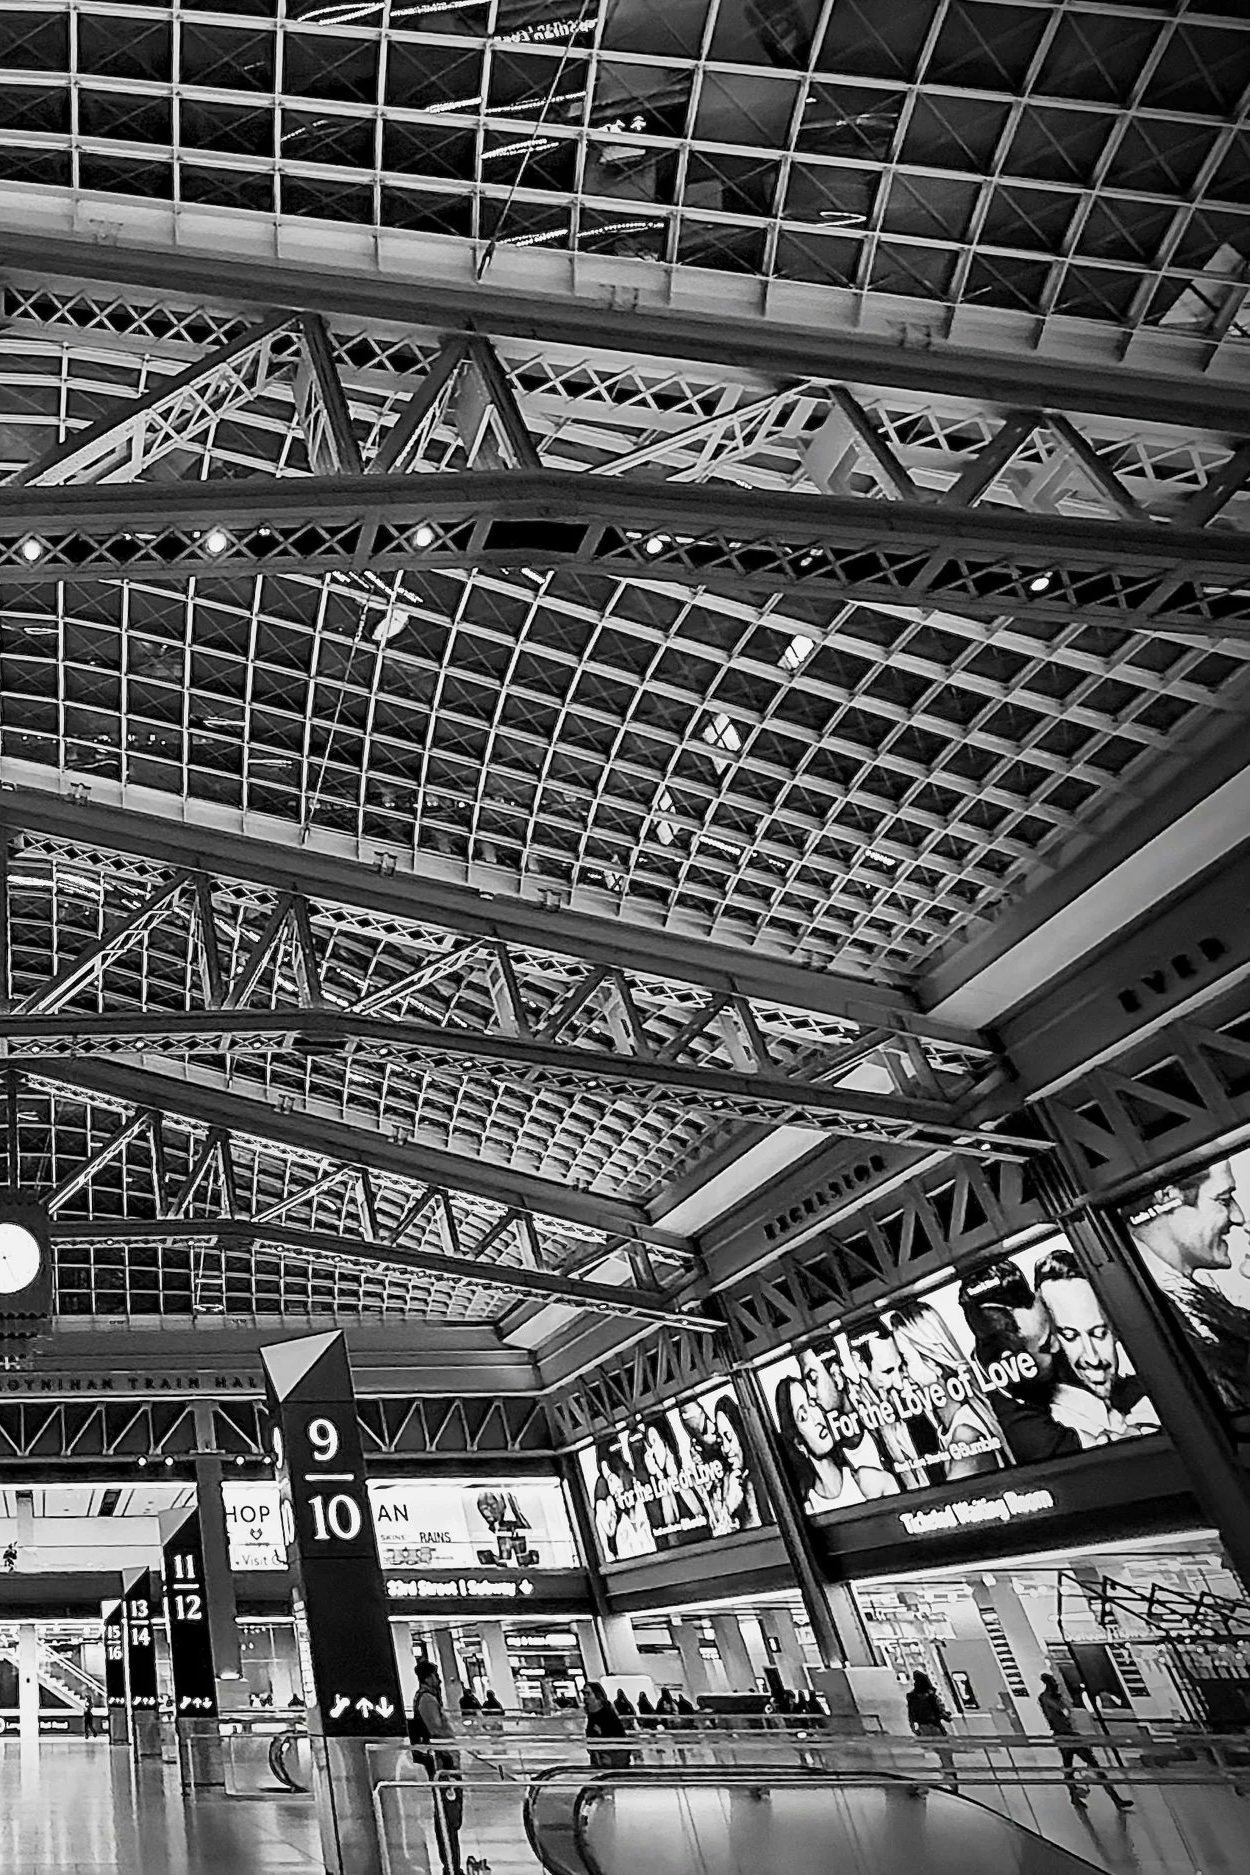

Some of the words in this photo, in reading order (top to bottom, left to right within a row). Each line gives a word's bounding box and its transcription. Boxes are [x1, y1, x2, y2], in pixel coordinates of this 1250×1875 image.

[764, 1154, 887, 1240] EXCELSIOR
[127, 1378, 200, 1390] TRAIN
[214, 1376, 257, 1389] HAL
[826, 1410, 861, 1441] For
[858, 1399, 896, 1430] the
[889, 1382, 947, 1419] Love
[946, 1364, 974, 1402] of
[971, 1352, 1038, 1393] Love
[309, 1418, 338, 1461] 9
[692, 1460, 724, 1486] Love
[308, 1494, 362, 1540] 10
[377, 1504, 410, 1522] AN
[419, 1531, 452, 1544] RAINS
[173, 1554, 196, 1579] 11
[241, 1554, 268, 1566] Visit
[131, 1599, 149, 1618] 13
[174, 1595, 202, 1620] 12
[107, 1625, 121, 1639] 15
[131, 1627, 151, 1647] 14
[108, 1645, 123, 1660] 16
